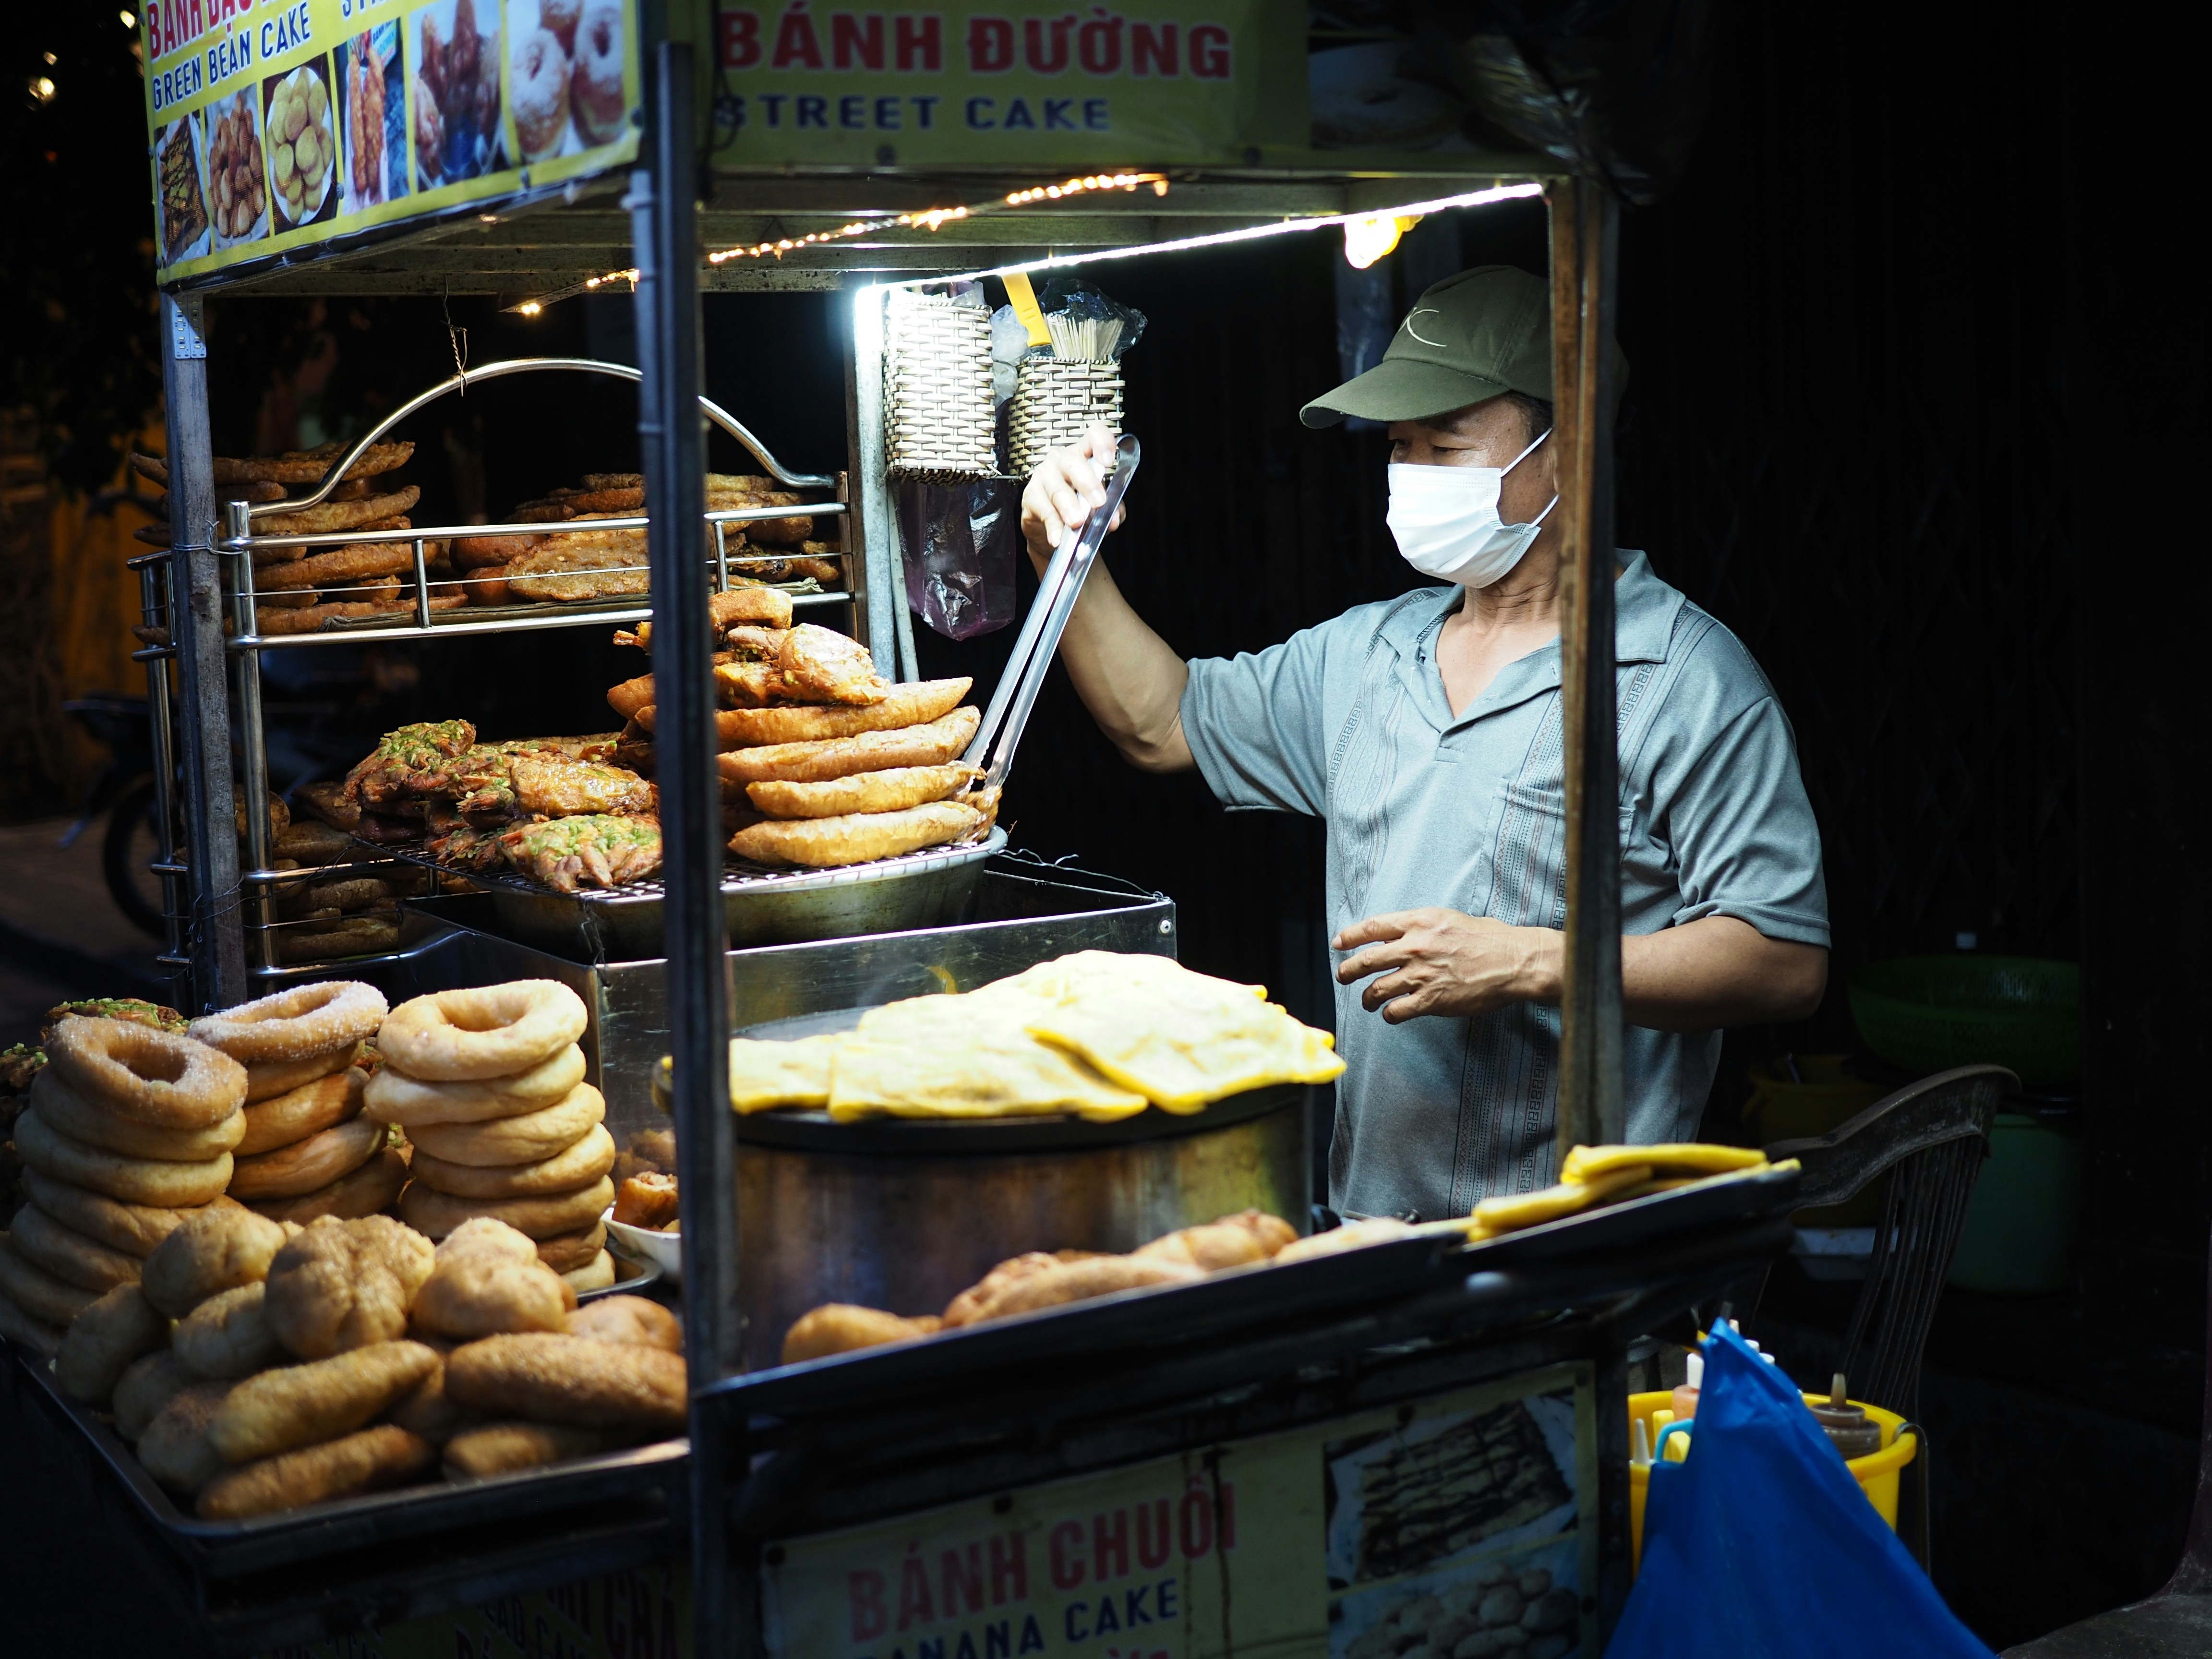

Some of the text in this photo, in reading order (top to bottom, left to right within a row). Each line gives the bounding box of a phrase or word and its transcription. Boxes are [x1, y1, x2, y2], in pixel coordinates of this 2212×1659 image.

[153, 1, 311, 111] GREEN BEAN CAKE
[720, 2, 1229, 78] BÁNH ĐƯỜNG
[712, 96, 1109, 130] STREET CAKE
[848, 1530, 1028, 1642] BÁNH
[1066, 1579, 1178, 1642] CAKE
